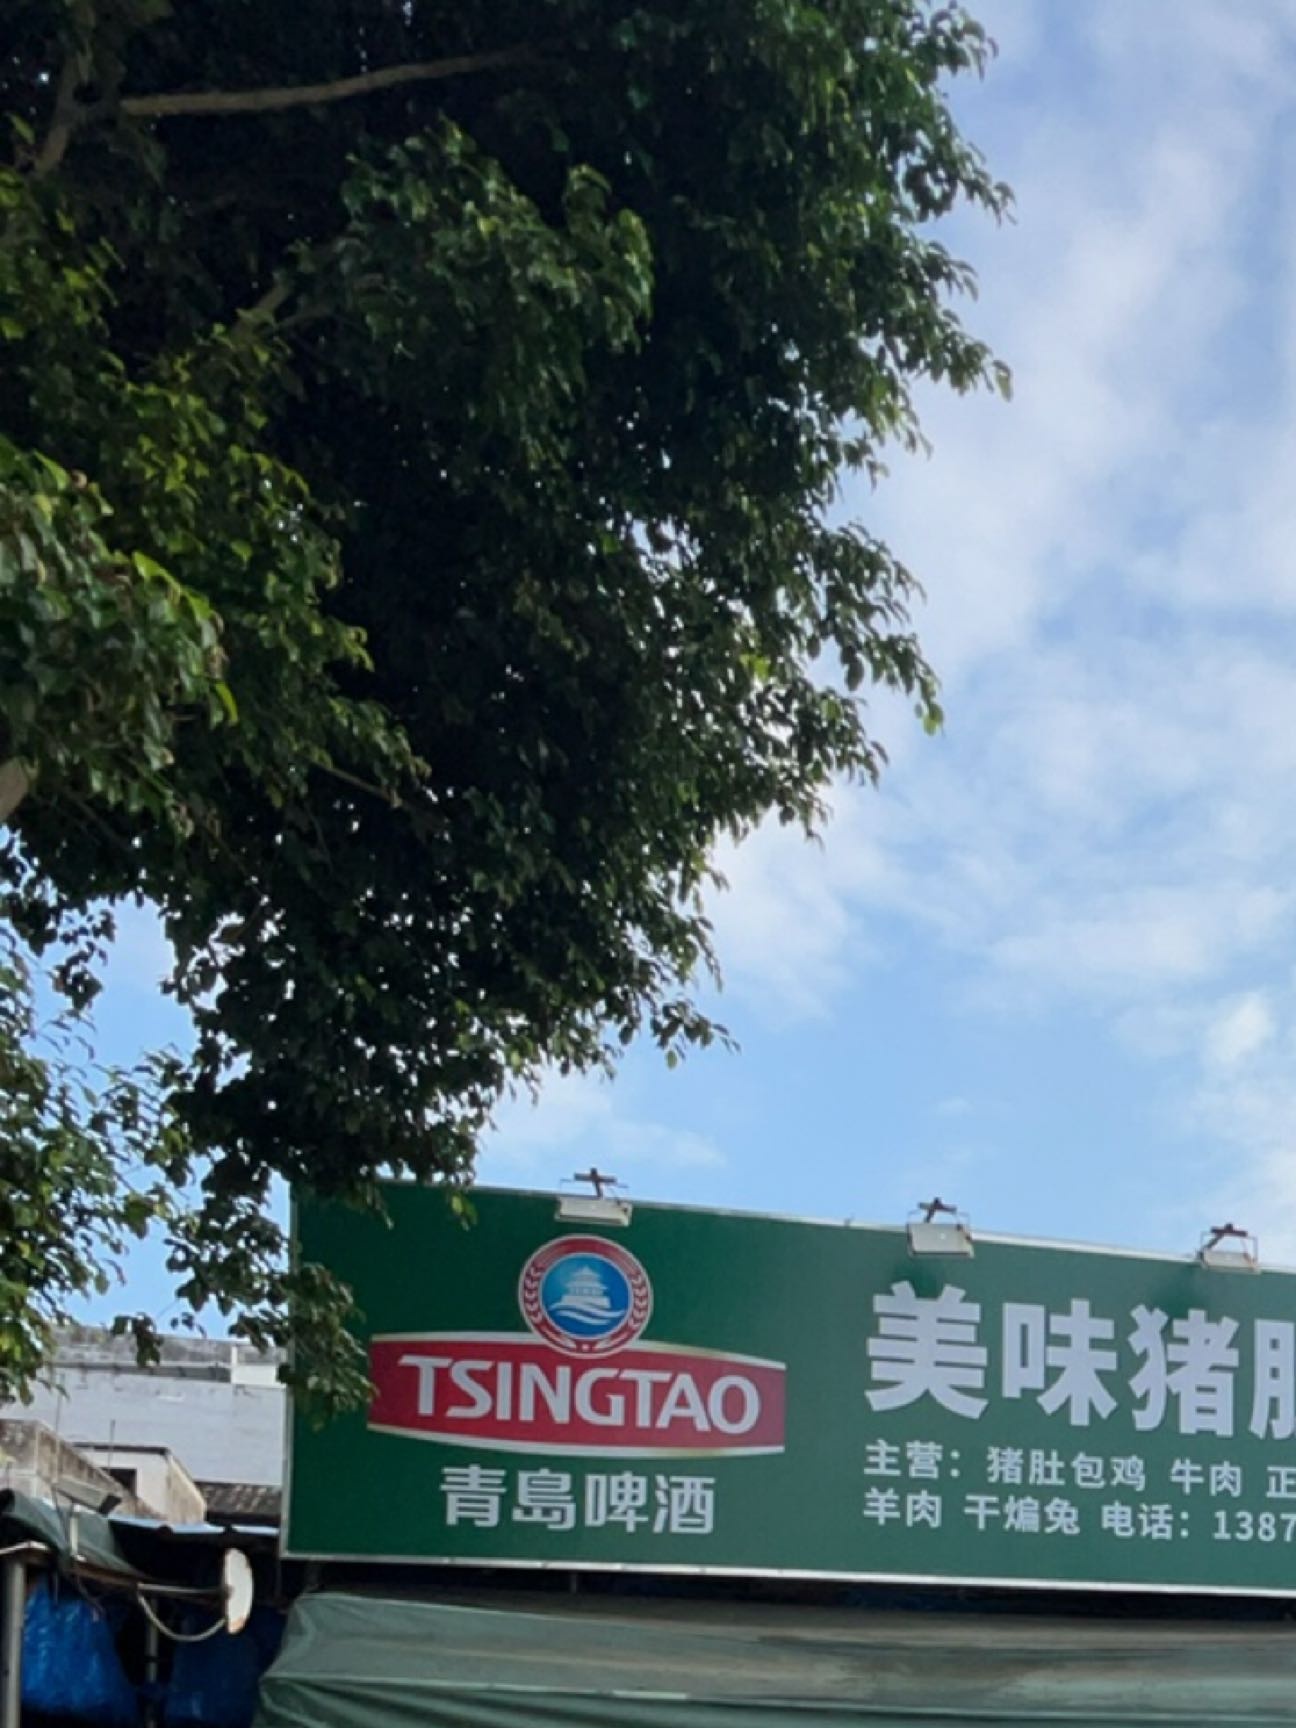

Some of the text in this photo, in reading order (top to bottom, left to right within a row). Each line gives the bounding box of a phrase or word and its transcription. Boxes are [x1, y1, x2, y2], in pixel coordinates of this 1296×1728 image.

[398, 1354, 761, 1435] TSINGTAO
[1169, 1457, 1242, 1499] 牛肉
[863, 1486, 943, 1528] 羊肉
